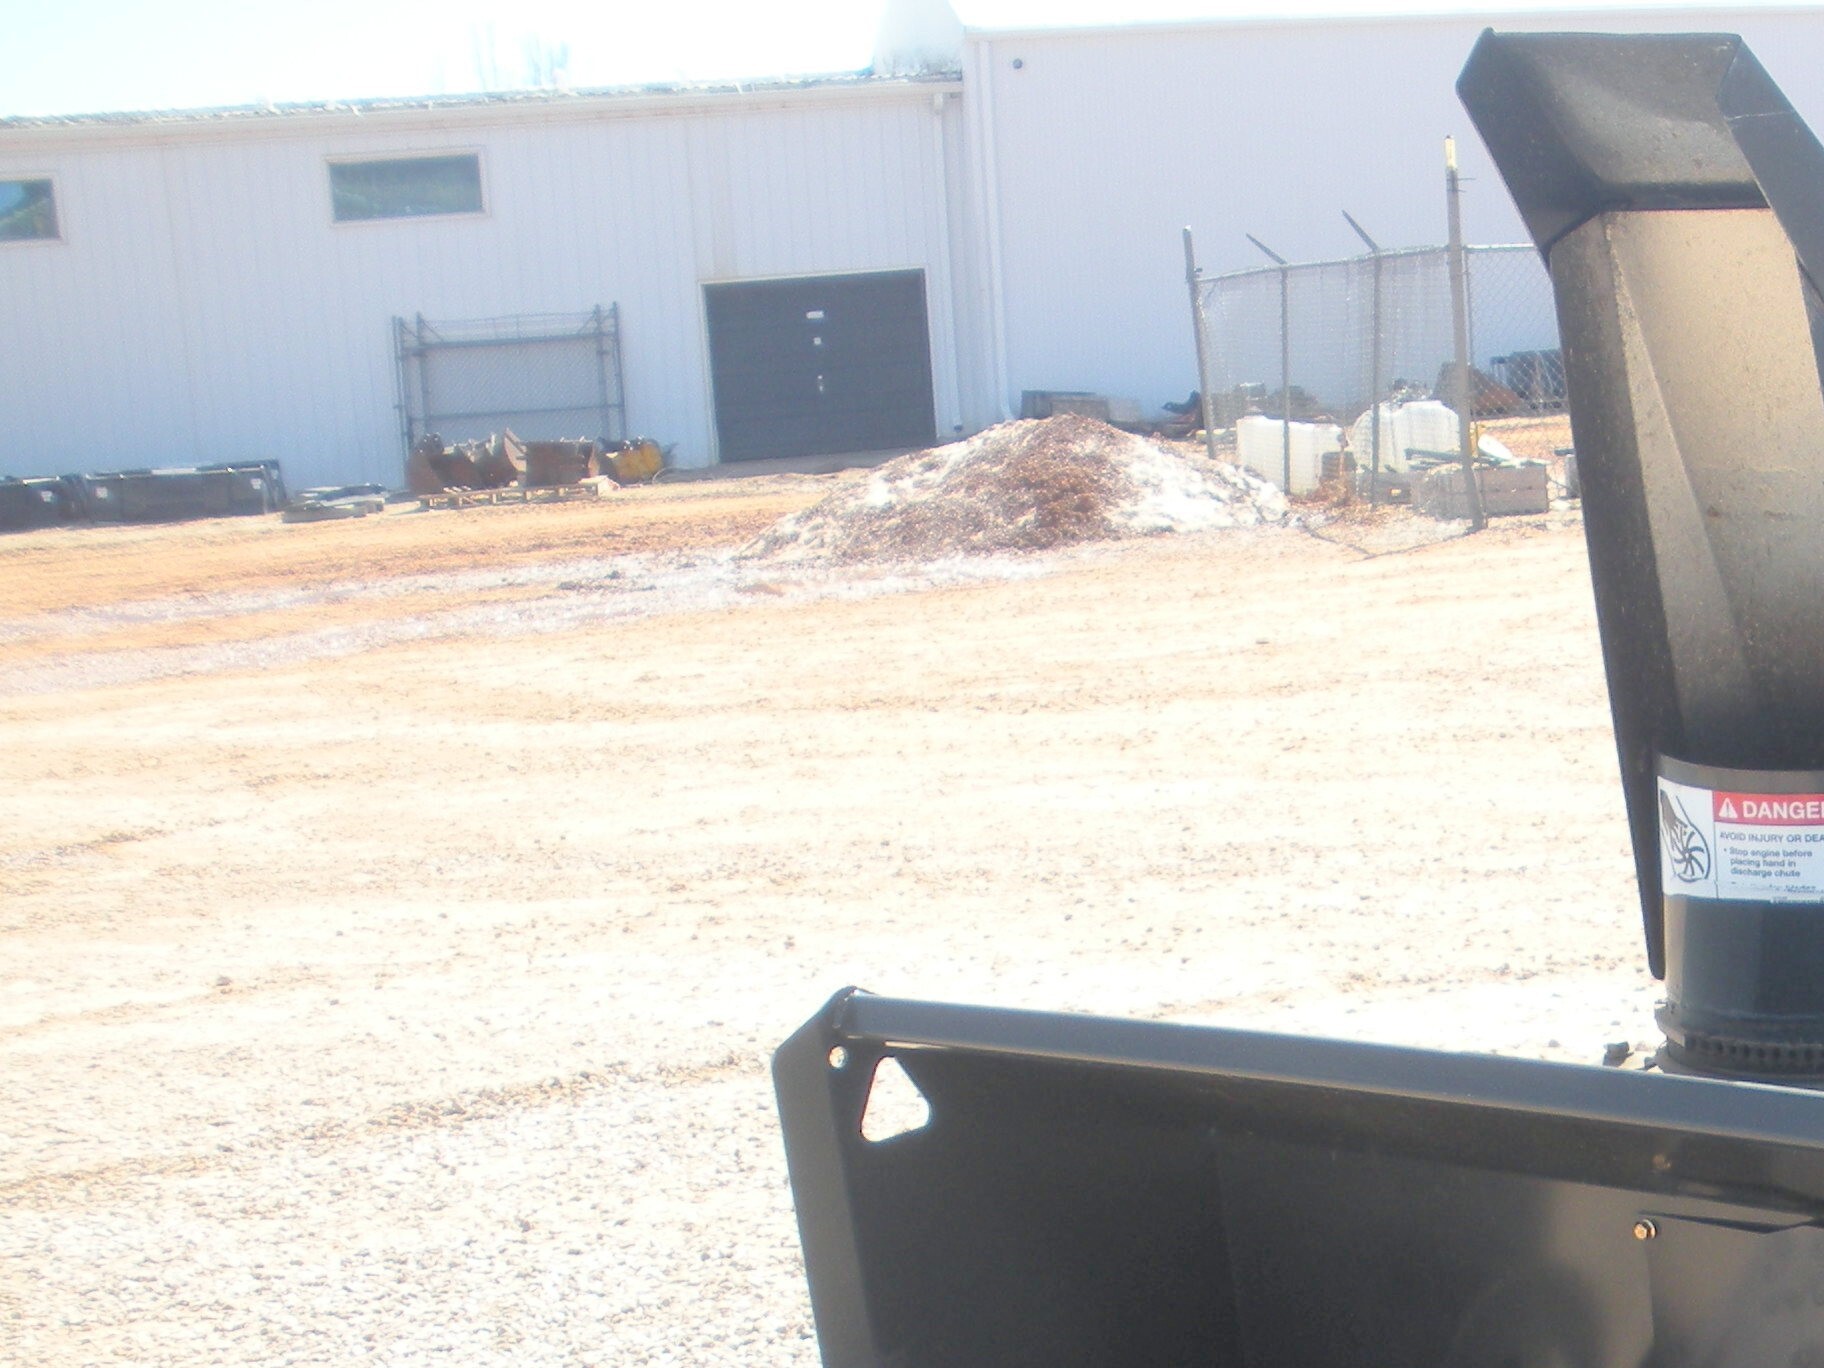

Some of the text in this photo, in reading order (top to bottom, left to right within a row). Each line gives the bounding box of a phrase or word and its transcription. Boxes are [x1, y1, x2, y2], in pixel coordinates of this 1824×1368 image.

[1720, 831, 1746, 841] AVOID
[1748, 833, 1783, 843] INJURY
[1786, 834, 1802, 843] OR
[1729, 846, 1813, 858] Stop engine before
[1730, 858, 1797, 868] placing hand in
[1731, 867, 1801, 878] discharge chute
